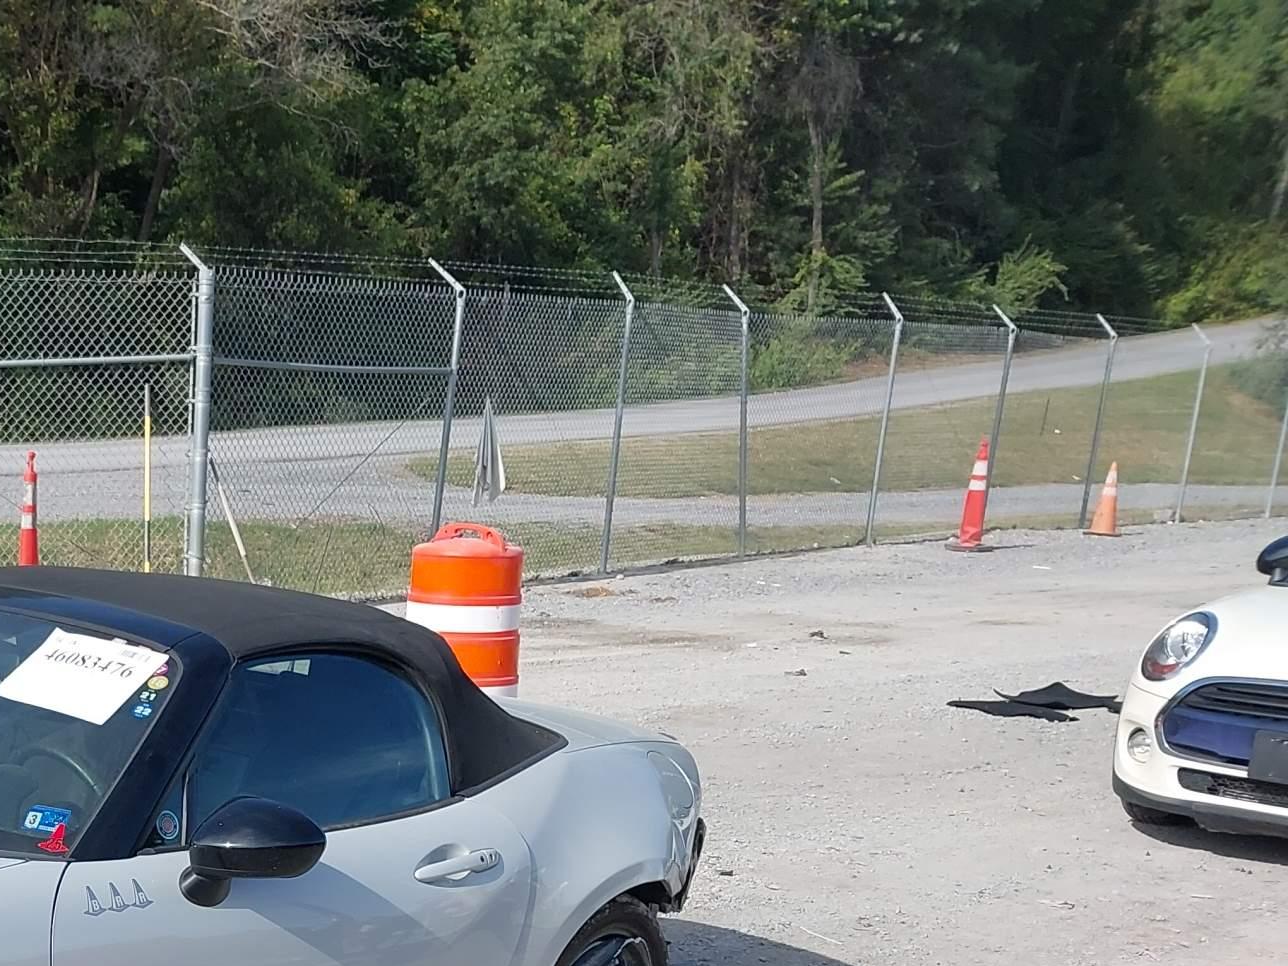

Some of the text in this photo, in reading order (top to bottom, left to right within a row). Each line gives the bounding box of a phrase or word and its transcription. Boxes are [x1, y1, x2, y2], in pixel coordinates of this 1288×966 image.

[44, 648, 134, 679] 46083476
[139, 691, 157, 701] 21
[134, 705, 152, 716] 22
[29, 814, 38, 825] 3
